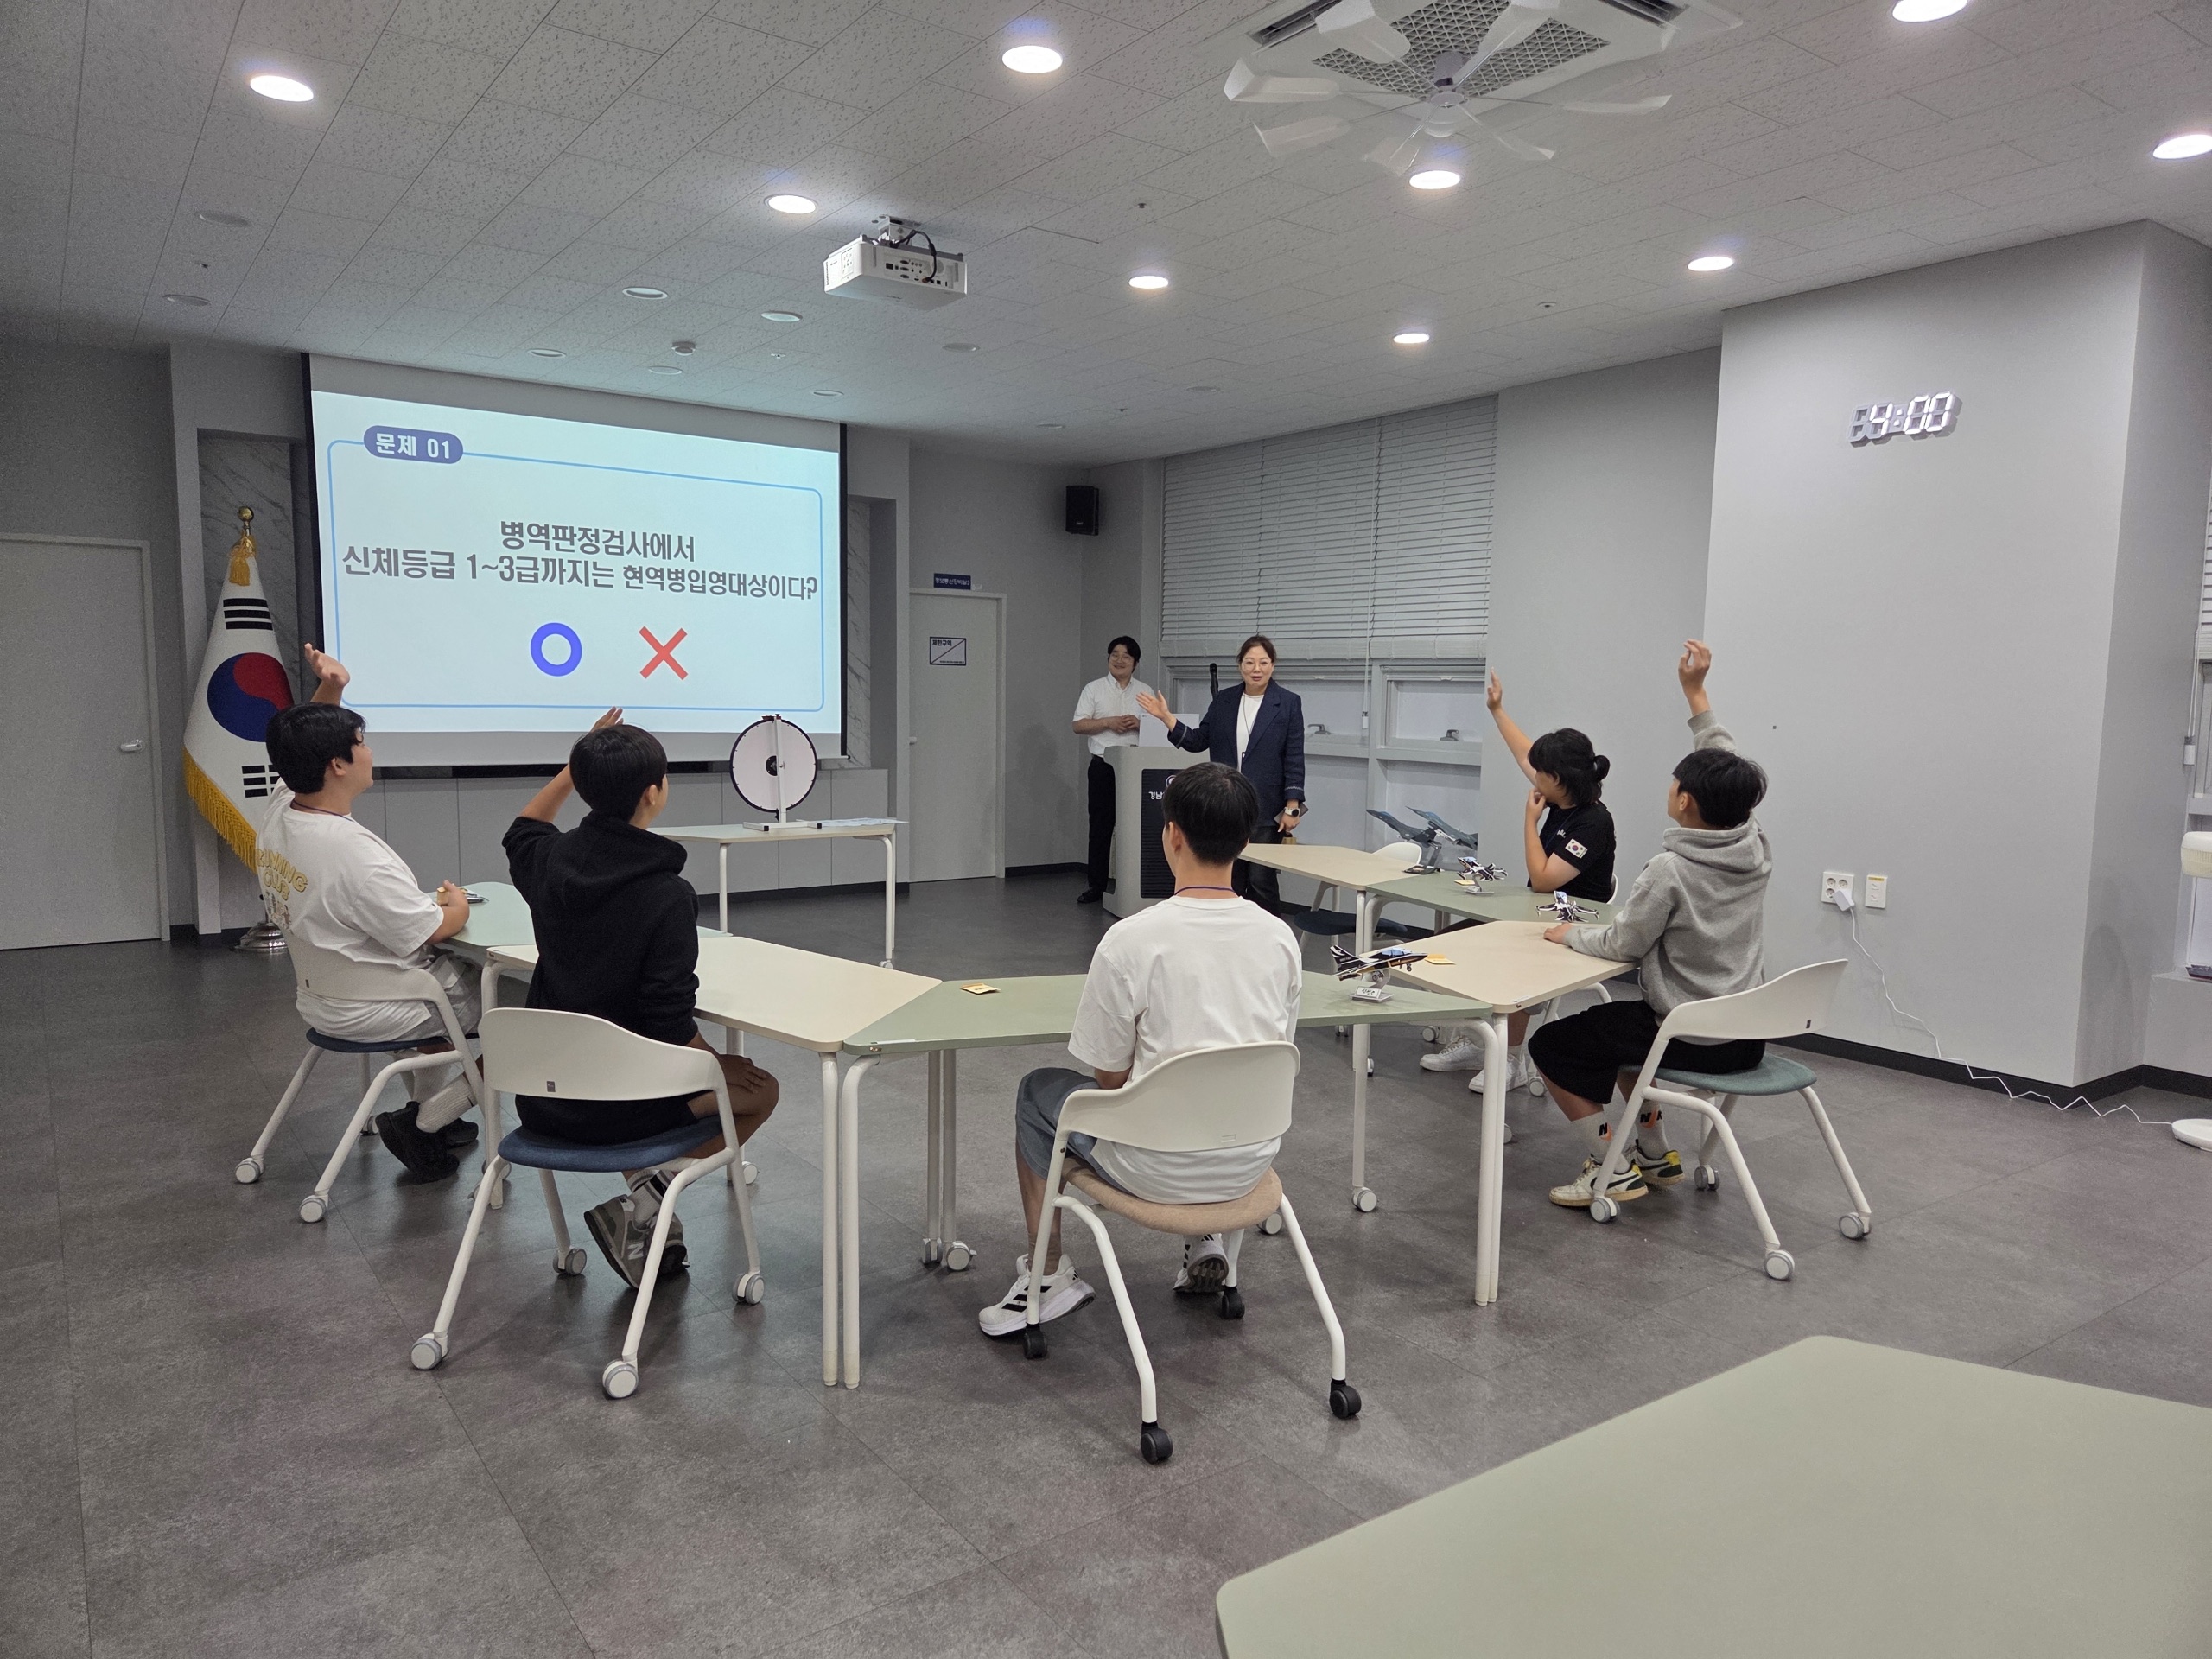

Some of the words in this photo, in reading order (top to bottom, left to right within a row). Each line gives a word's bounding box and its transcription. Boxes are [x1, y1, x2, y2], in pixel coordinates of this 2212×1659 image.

[375, 432, 416, 457] 문제
[427, 438, 450, 460] 01
[500, 520, 695, 562] 병역판정검사에서
[342, 545, 455, 580] 신체등급
[466, 554, 615, 589] 1~3급까지는
[622, 564, 818, 601] 현역병입영대상이다?
[1148, 791, 1165, 800] 경남
